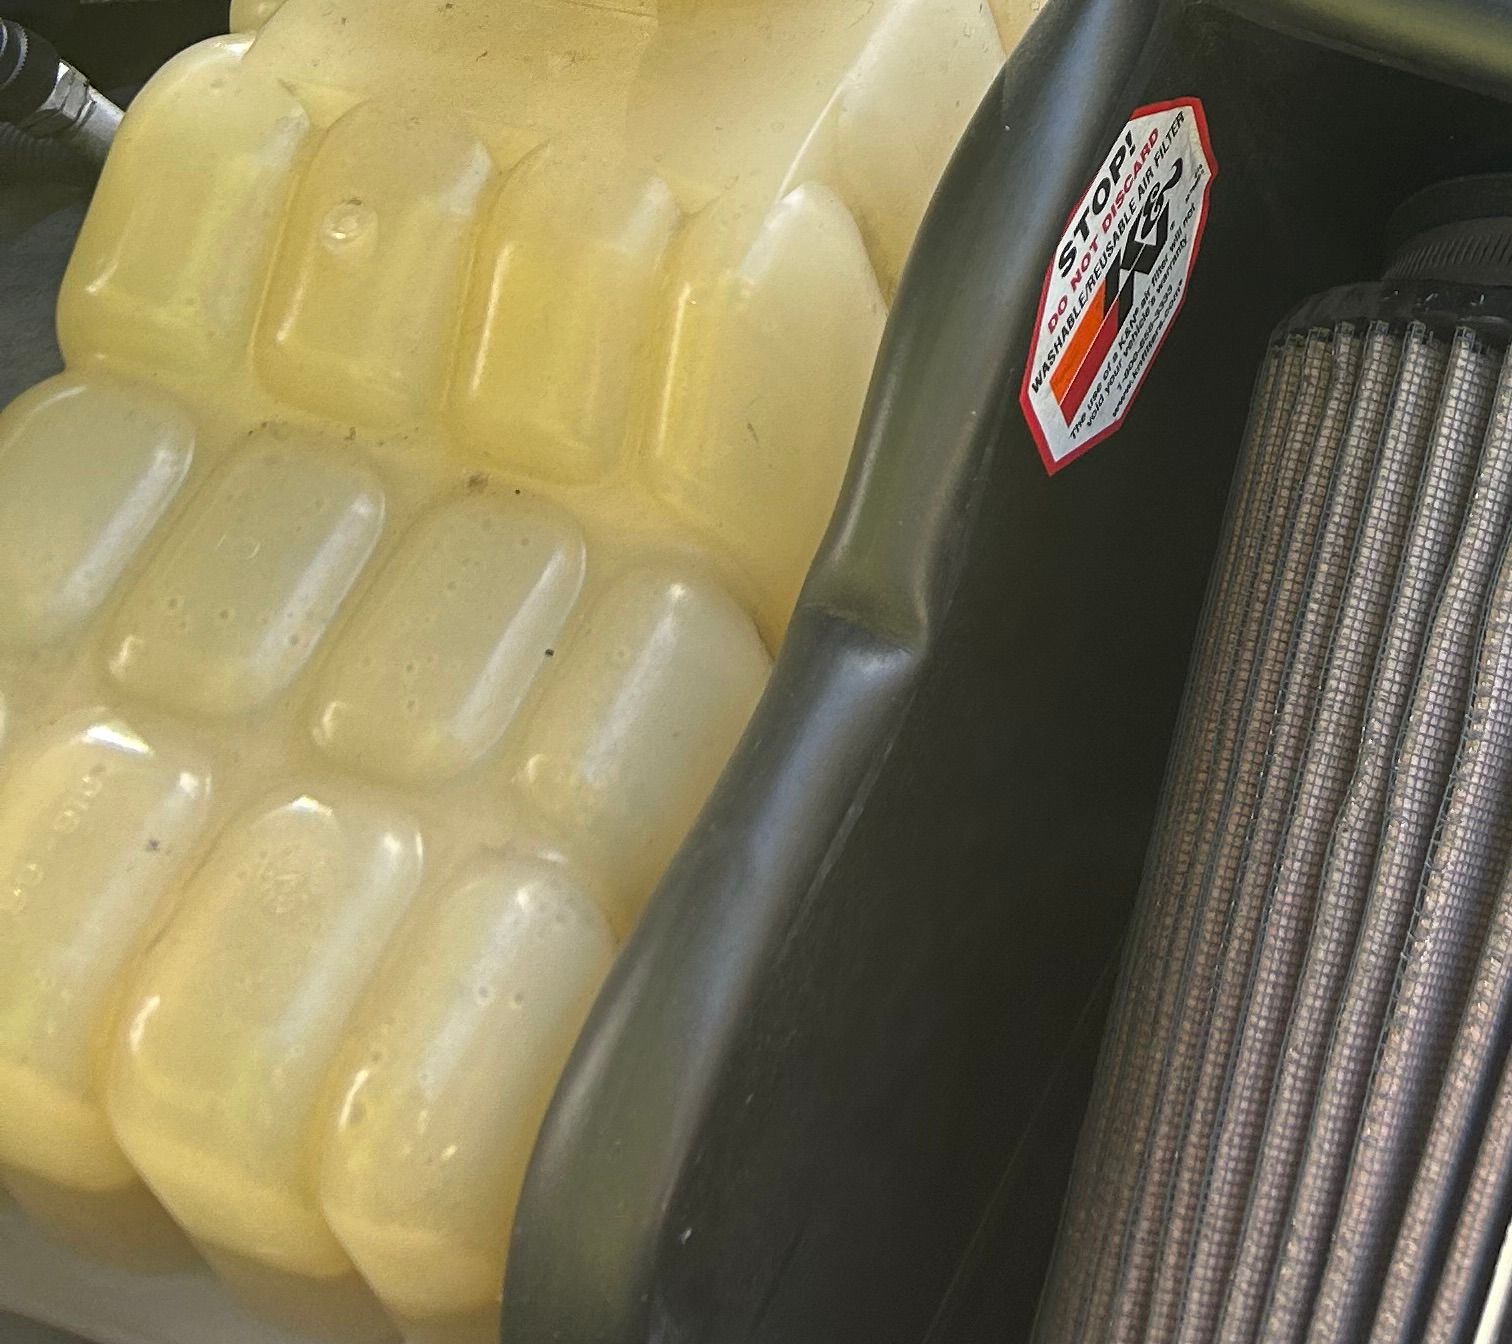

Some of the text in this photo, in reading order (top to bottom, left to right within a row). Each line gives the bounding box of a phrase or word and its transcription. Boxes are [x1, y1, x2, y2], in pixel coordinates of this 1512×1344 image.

[1031, 110, 1185, 394] WASHABLE/REUSABLE AIR FILTER
[1047, 128, 1159, 334] DO NOT DISCARD
[1058, 130, 1136, 278] STOP!
[1069, 412, 1087, 439] The
[1087, 382, 1102, 410] use
[1182, 202, 1195, 228] not
[1086, 393, 1105, 426] void
[1104, 358, 1122, 396] your
